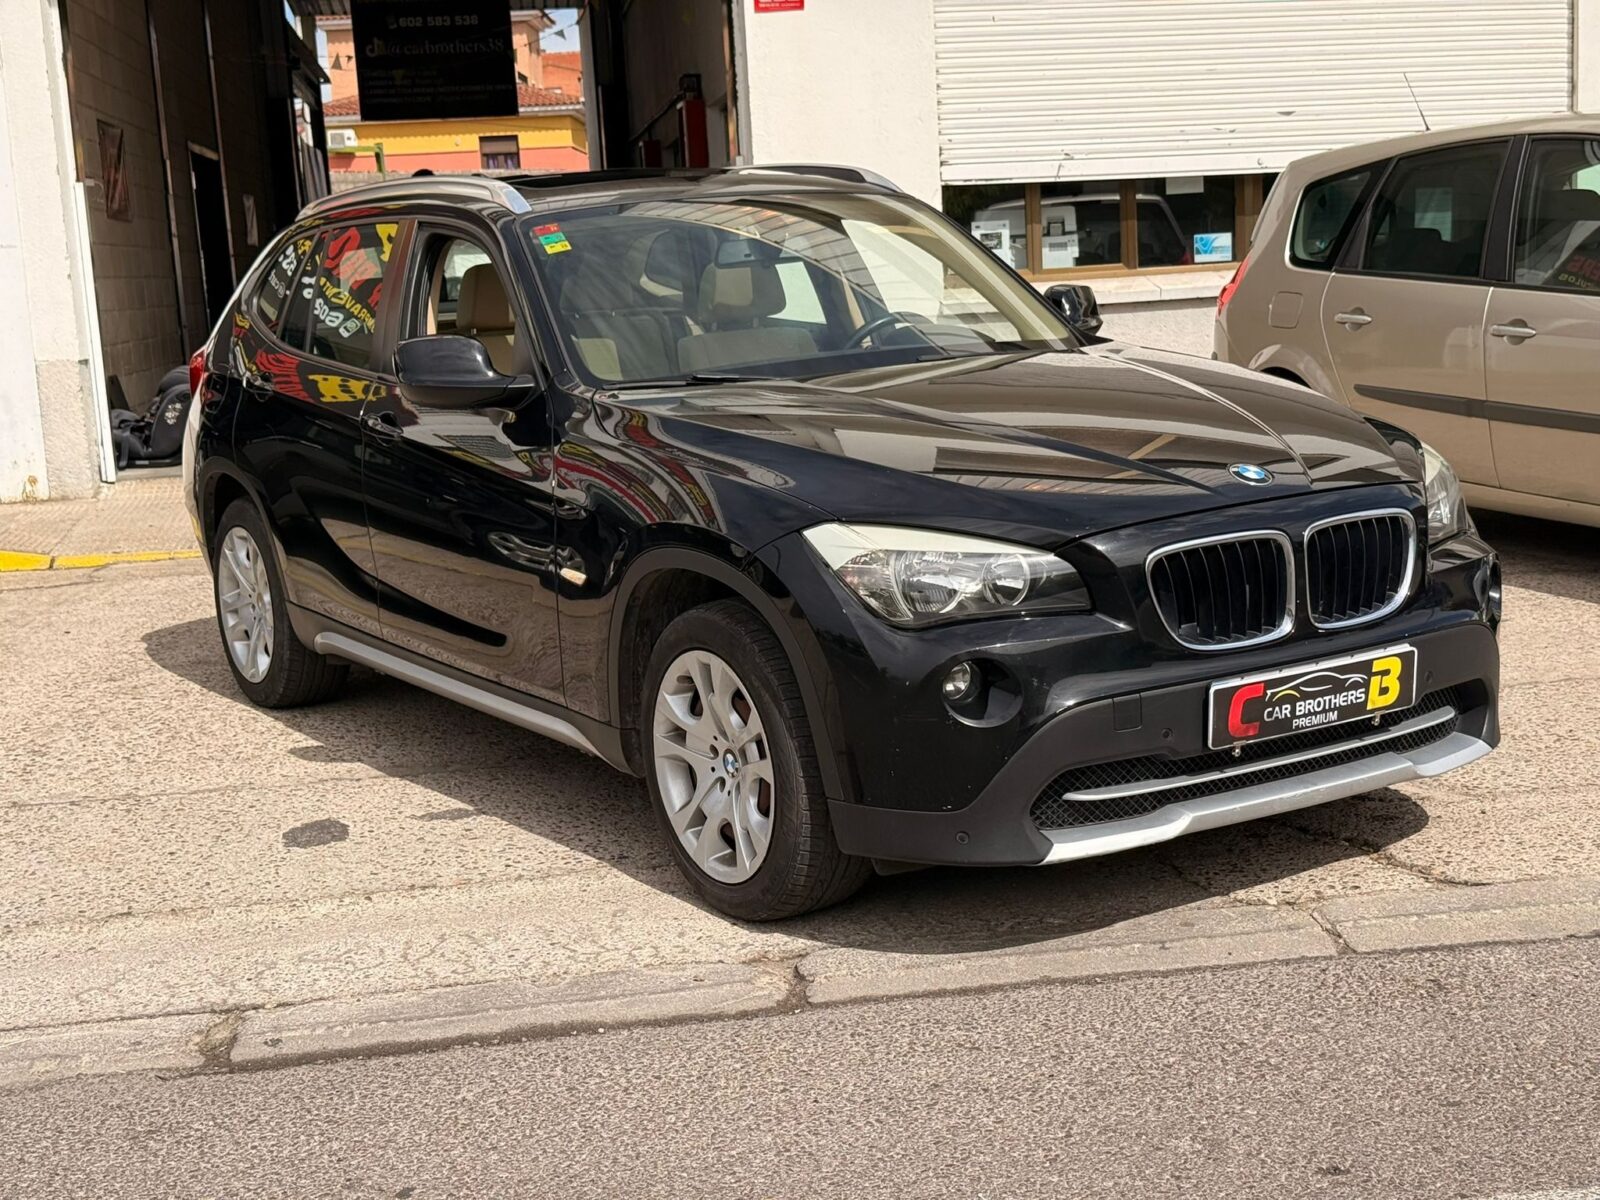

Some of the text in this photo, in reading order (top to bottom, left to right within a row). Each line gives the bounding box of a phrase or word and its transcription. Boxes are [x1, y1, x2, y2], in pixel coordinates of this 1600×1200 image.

[1264, 688, 1366, 722] CAR BROTHERS
[1292, 710, 1338, 729] PREMIUM
